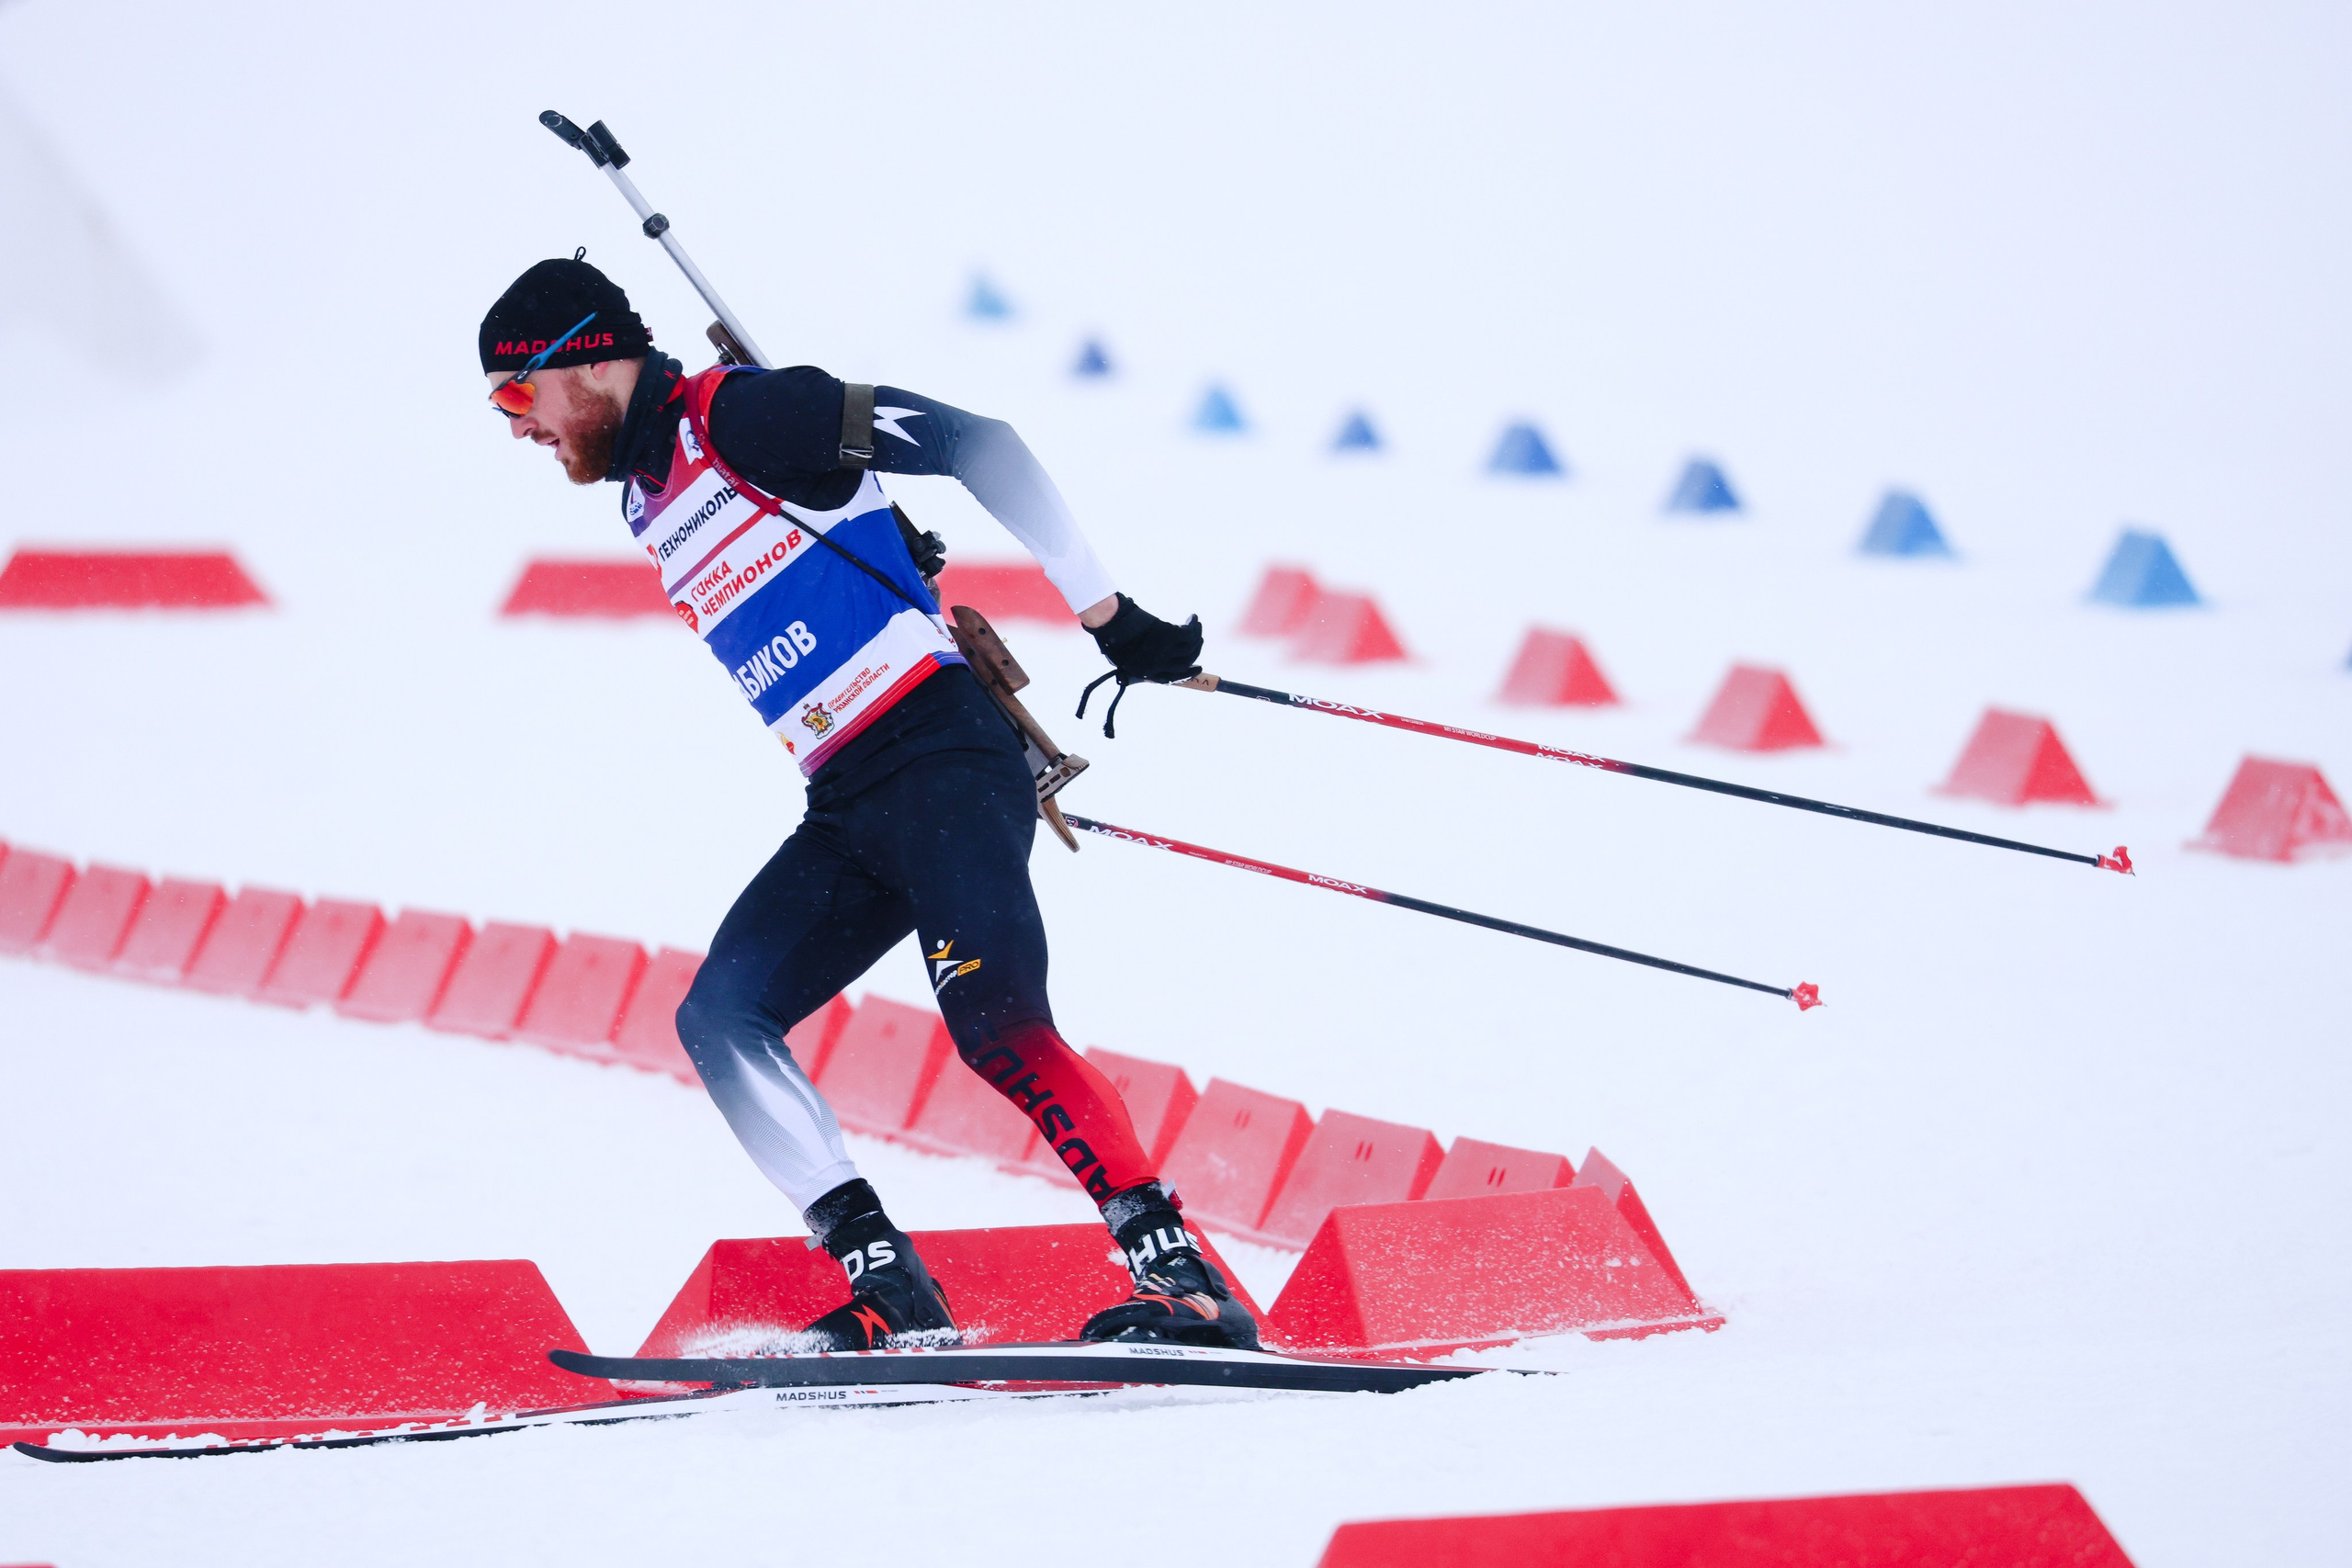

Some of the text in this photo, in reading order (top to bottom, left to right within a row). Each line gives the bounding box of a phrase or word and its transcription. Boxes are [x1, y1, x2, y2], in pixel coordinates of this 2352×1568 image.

[658, 486, 739, 562] ТЕХНОНИКОЛЬ
[691, 560, 733, 603] ГОНКА
[701, 528, 802, 616] ЧЕМПИОНОВ
[828, 667, 871, 709] ПРАВИТЕЛЬСТВО
[832, 663, 890, 714] РЯЗАНСКОЙ ОБЛАСТИ
[1288, 694, 1385, 720] MOAX
[1089, 825, 1174, 851] MOAX
[1308, 874, 1367, 894] MOAX
[959, 961, 979, 975] PRO
[1128, 1348, 1184, 1357] MADSHUS
[775, 1391, 847, 1402] MADSHUS
